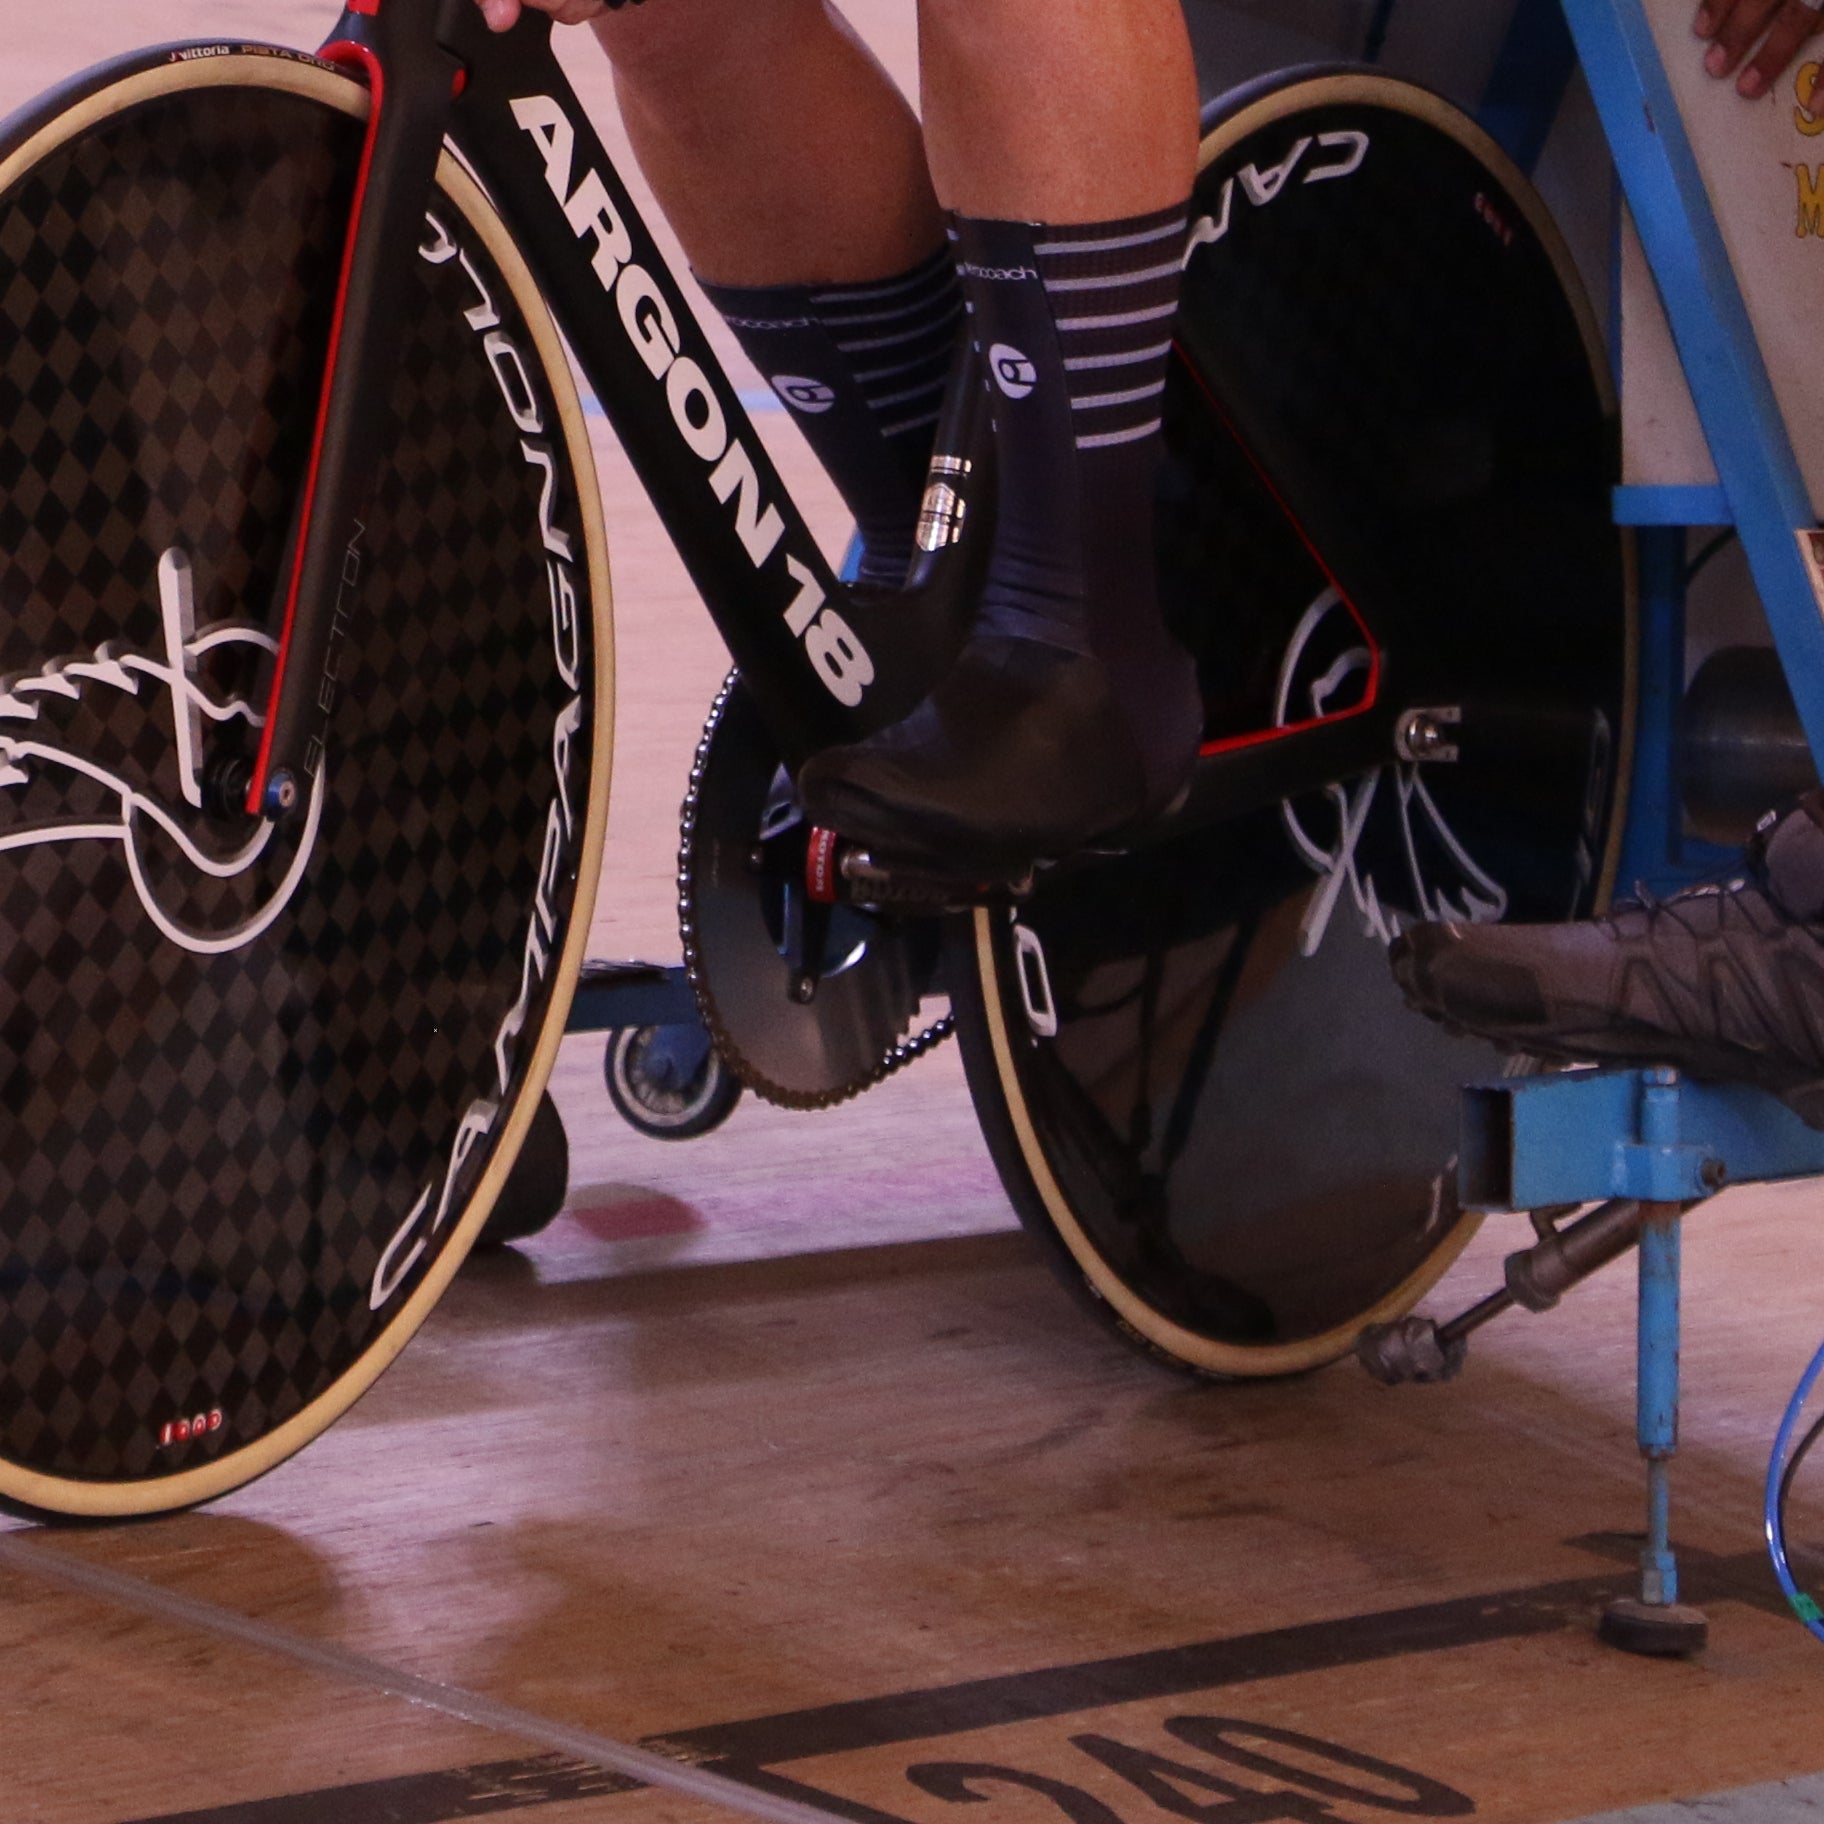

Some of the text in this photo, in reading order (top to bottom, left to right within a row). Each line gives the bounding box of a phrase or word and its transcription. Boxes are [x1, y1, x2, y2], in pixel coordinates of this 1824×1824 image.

[509, 94, 875, 708] ARGON 18
[303, 517, 366, 778] ELECTRON
[906, 1715, 1475, 1824] 240
